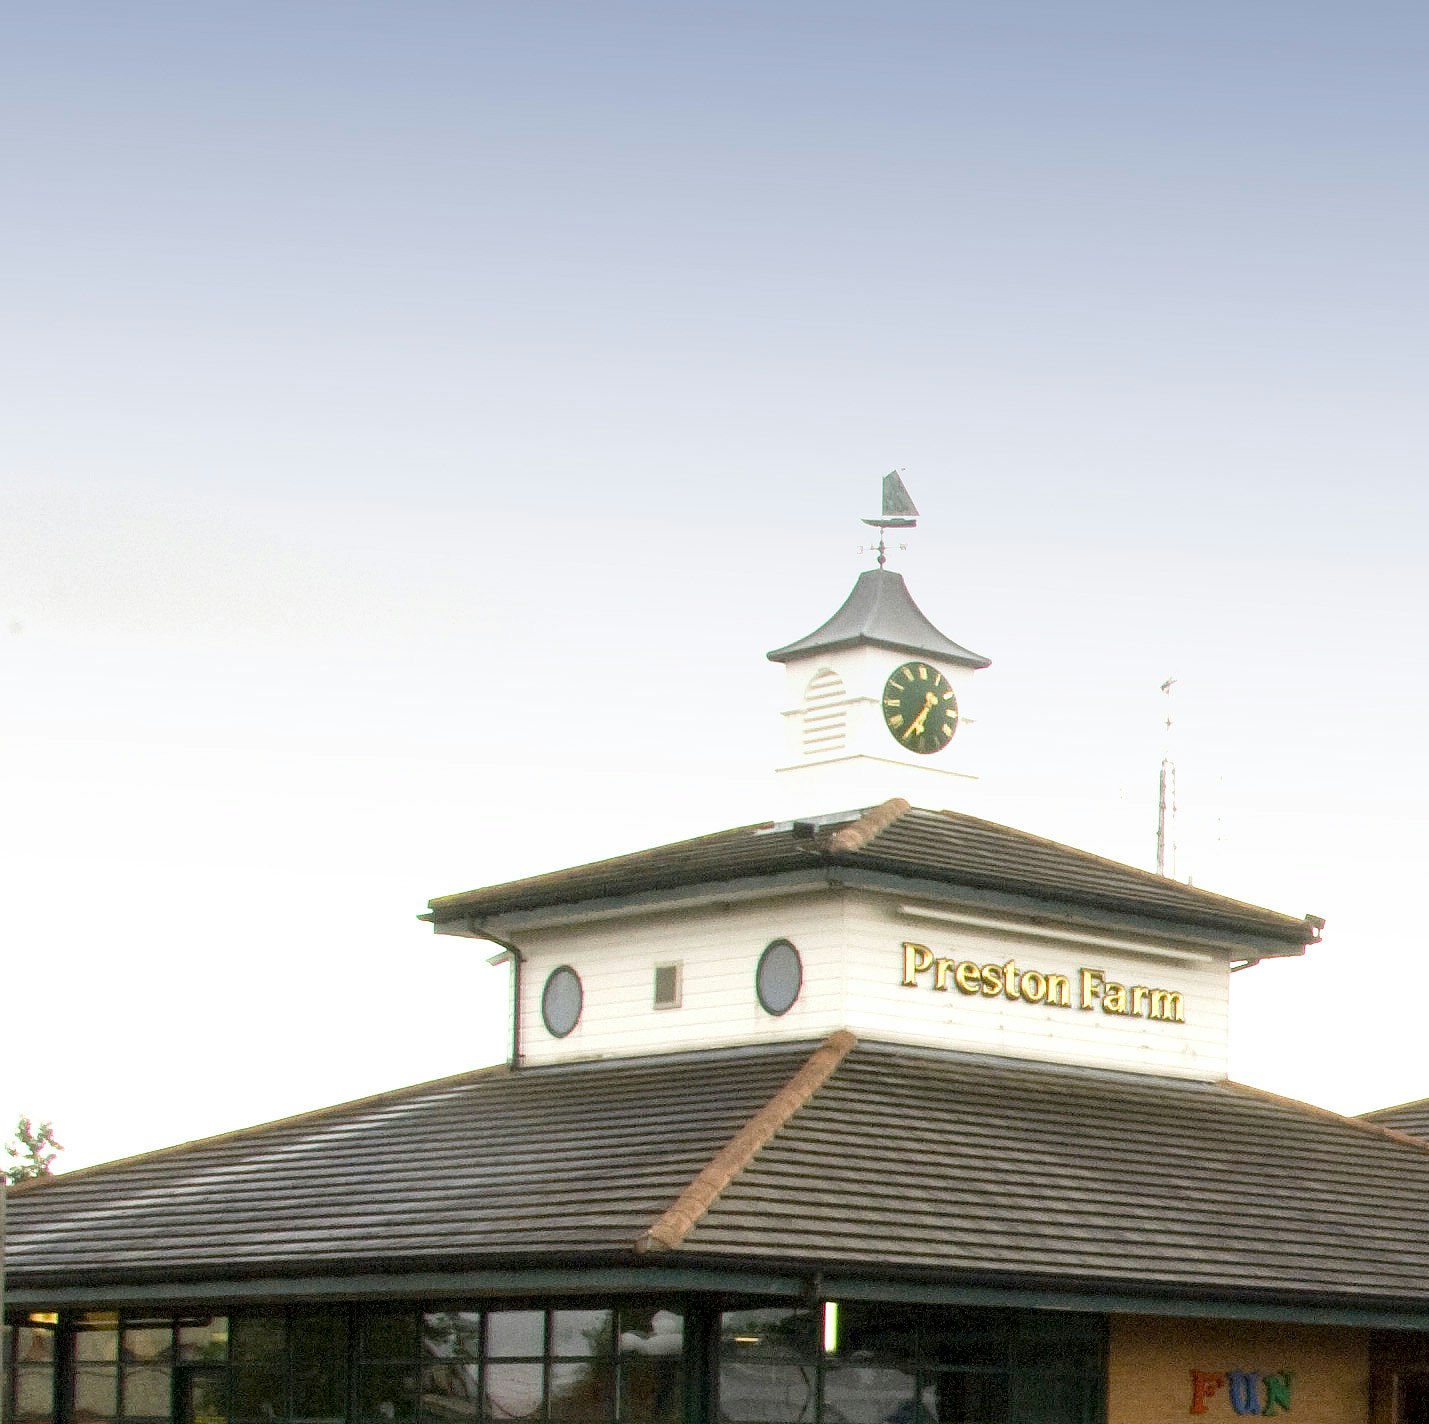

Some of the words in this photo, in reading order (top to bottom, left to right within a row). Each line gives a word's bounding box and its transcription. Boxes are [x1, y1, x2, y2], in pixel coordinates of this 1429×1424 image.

[901, 941, 1072, 1008] Preston
[1080, 967, 1186, 1023] Farm
[1189, 1369, 1297, 1417] FUN
